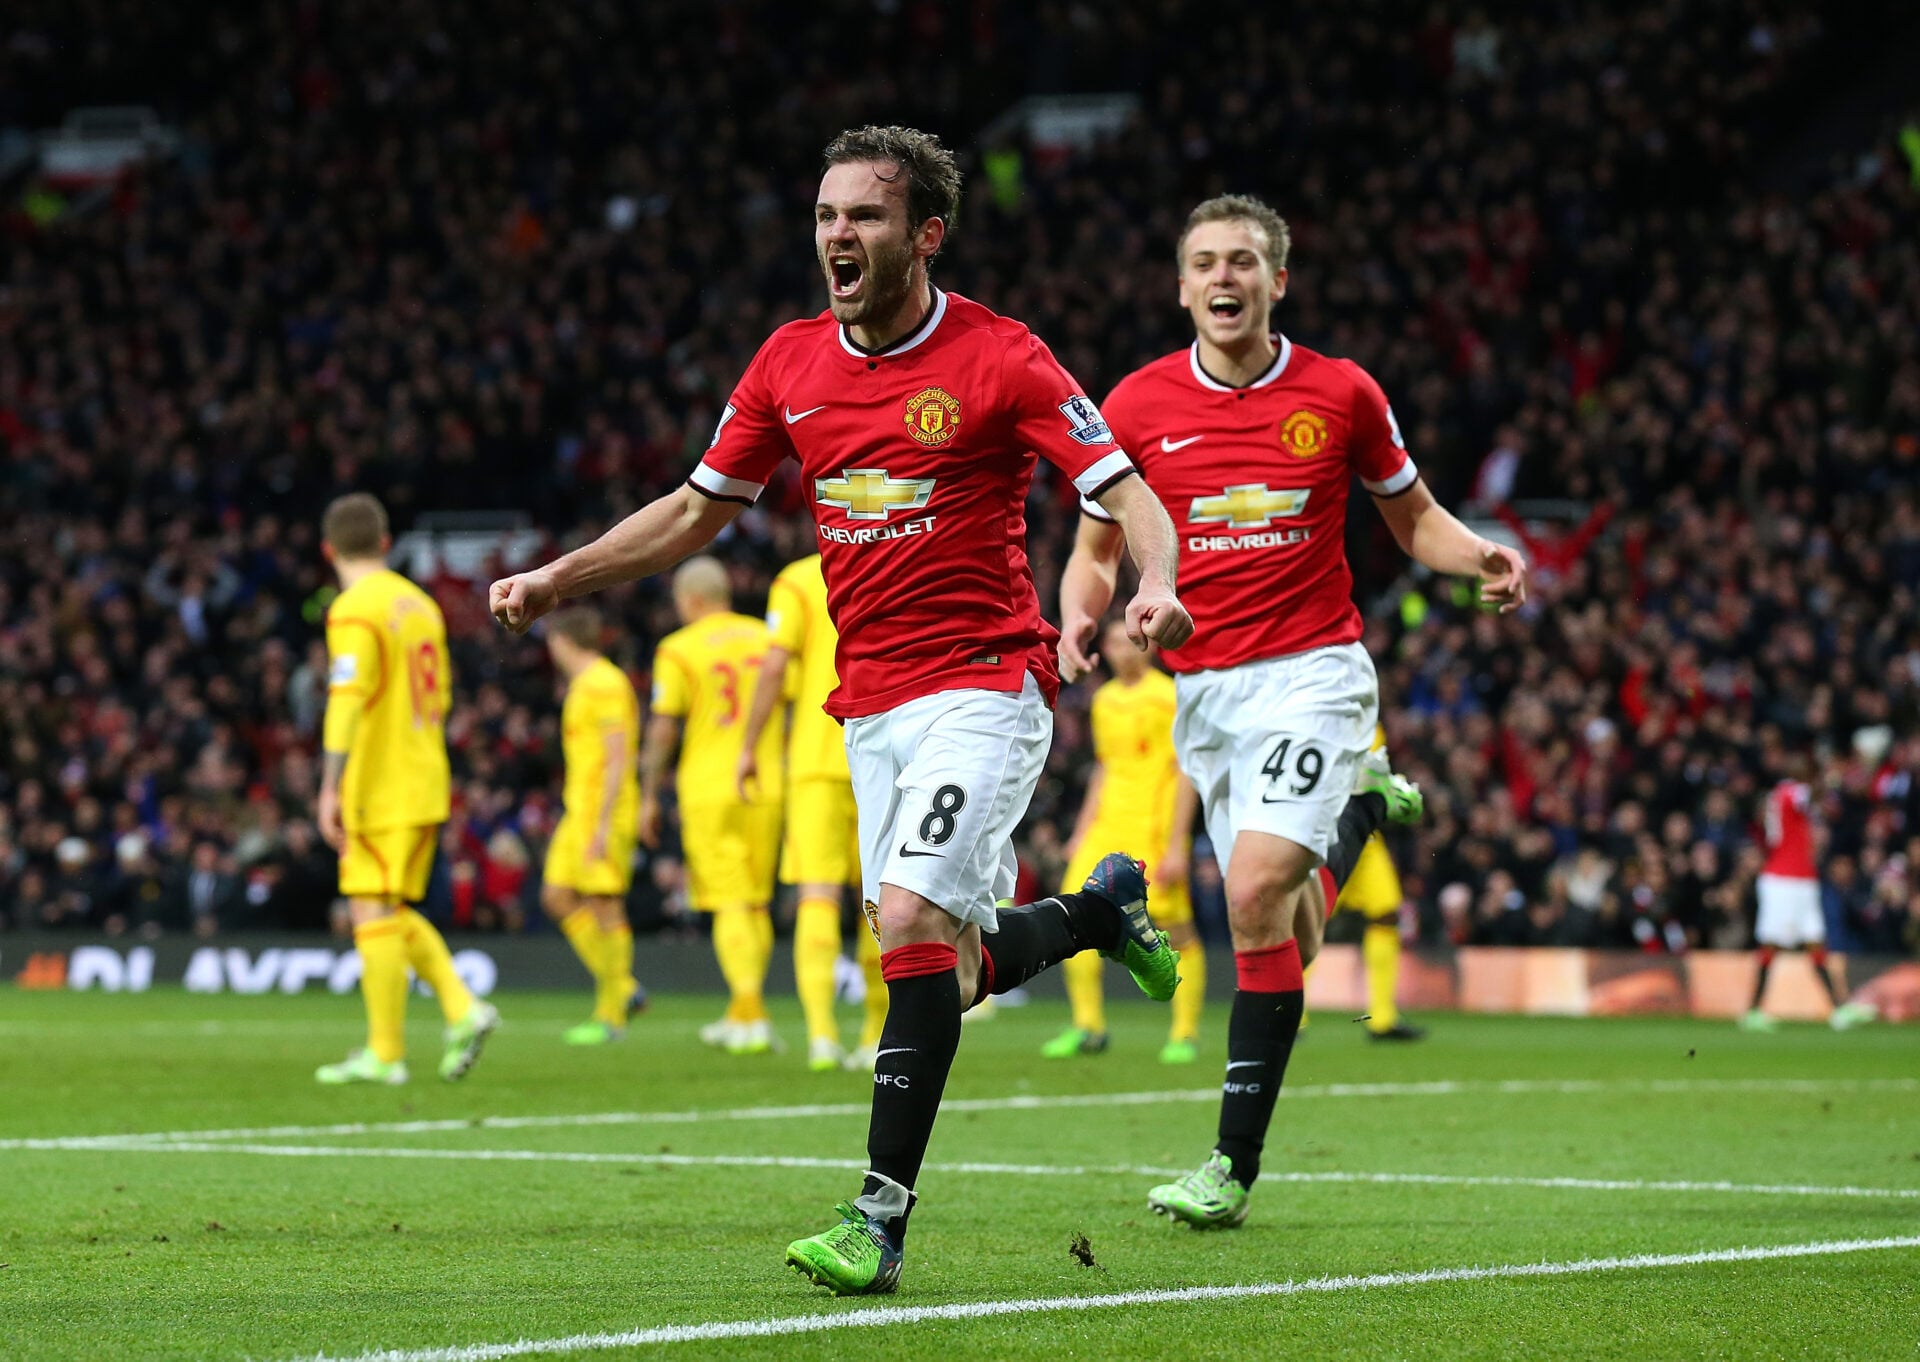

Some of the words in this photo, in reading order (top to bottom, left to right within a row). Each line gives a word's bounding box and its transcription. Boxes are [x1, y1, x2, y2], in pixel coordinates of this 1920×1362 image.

[910, 391, 956, 412] MANCHESTER
[915, 431, 948, 441] UNITED
[819, 516, 937, 544] CHEVROLET
[1188, 528, 1312, 552] CHEVROLET
[1261, 739, 1323, 795] 49
[918, 783, 968, 847] 8
